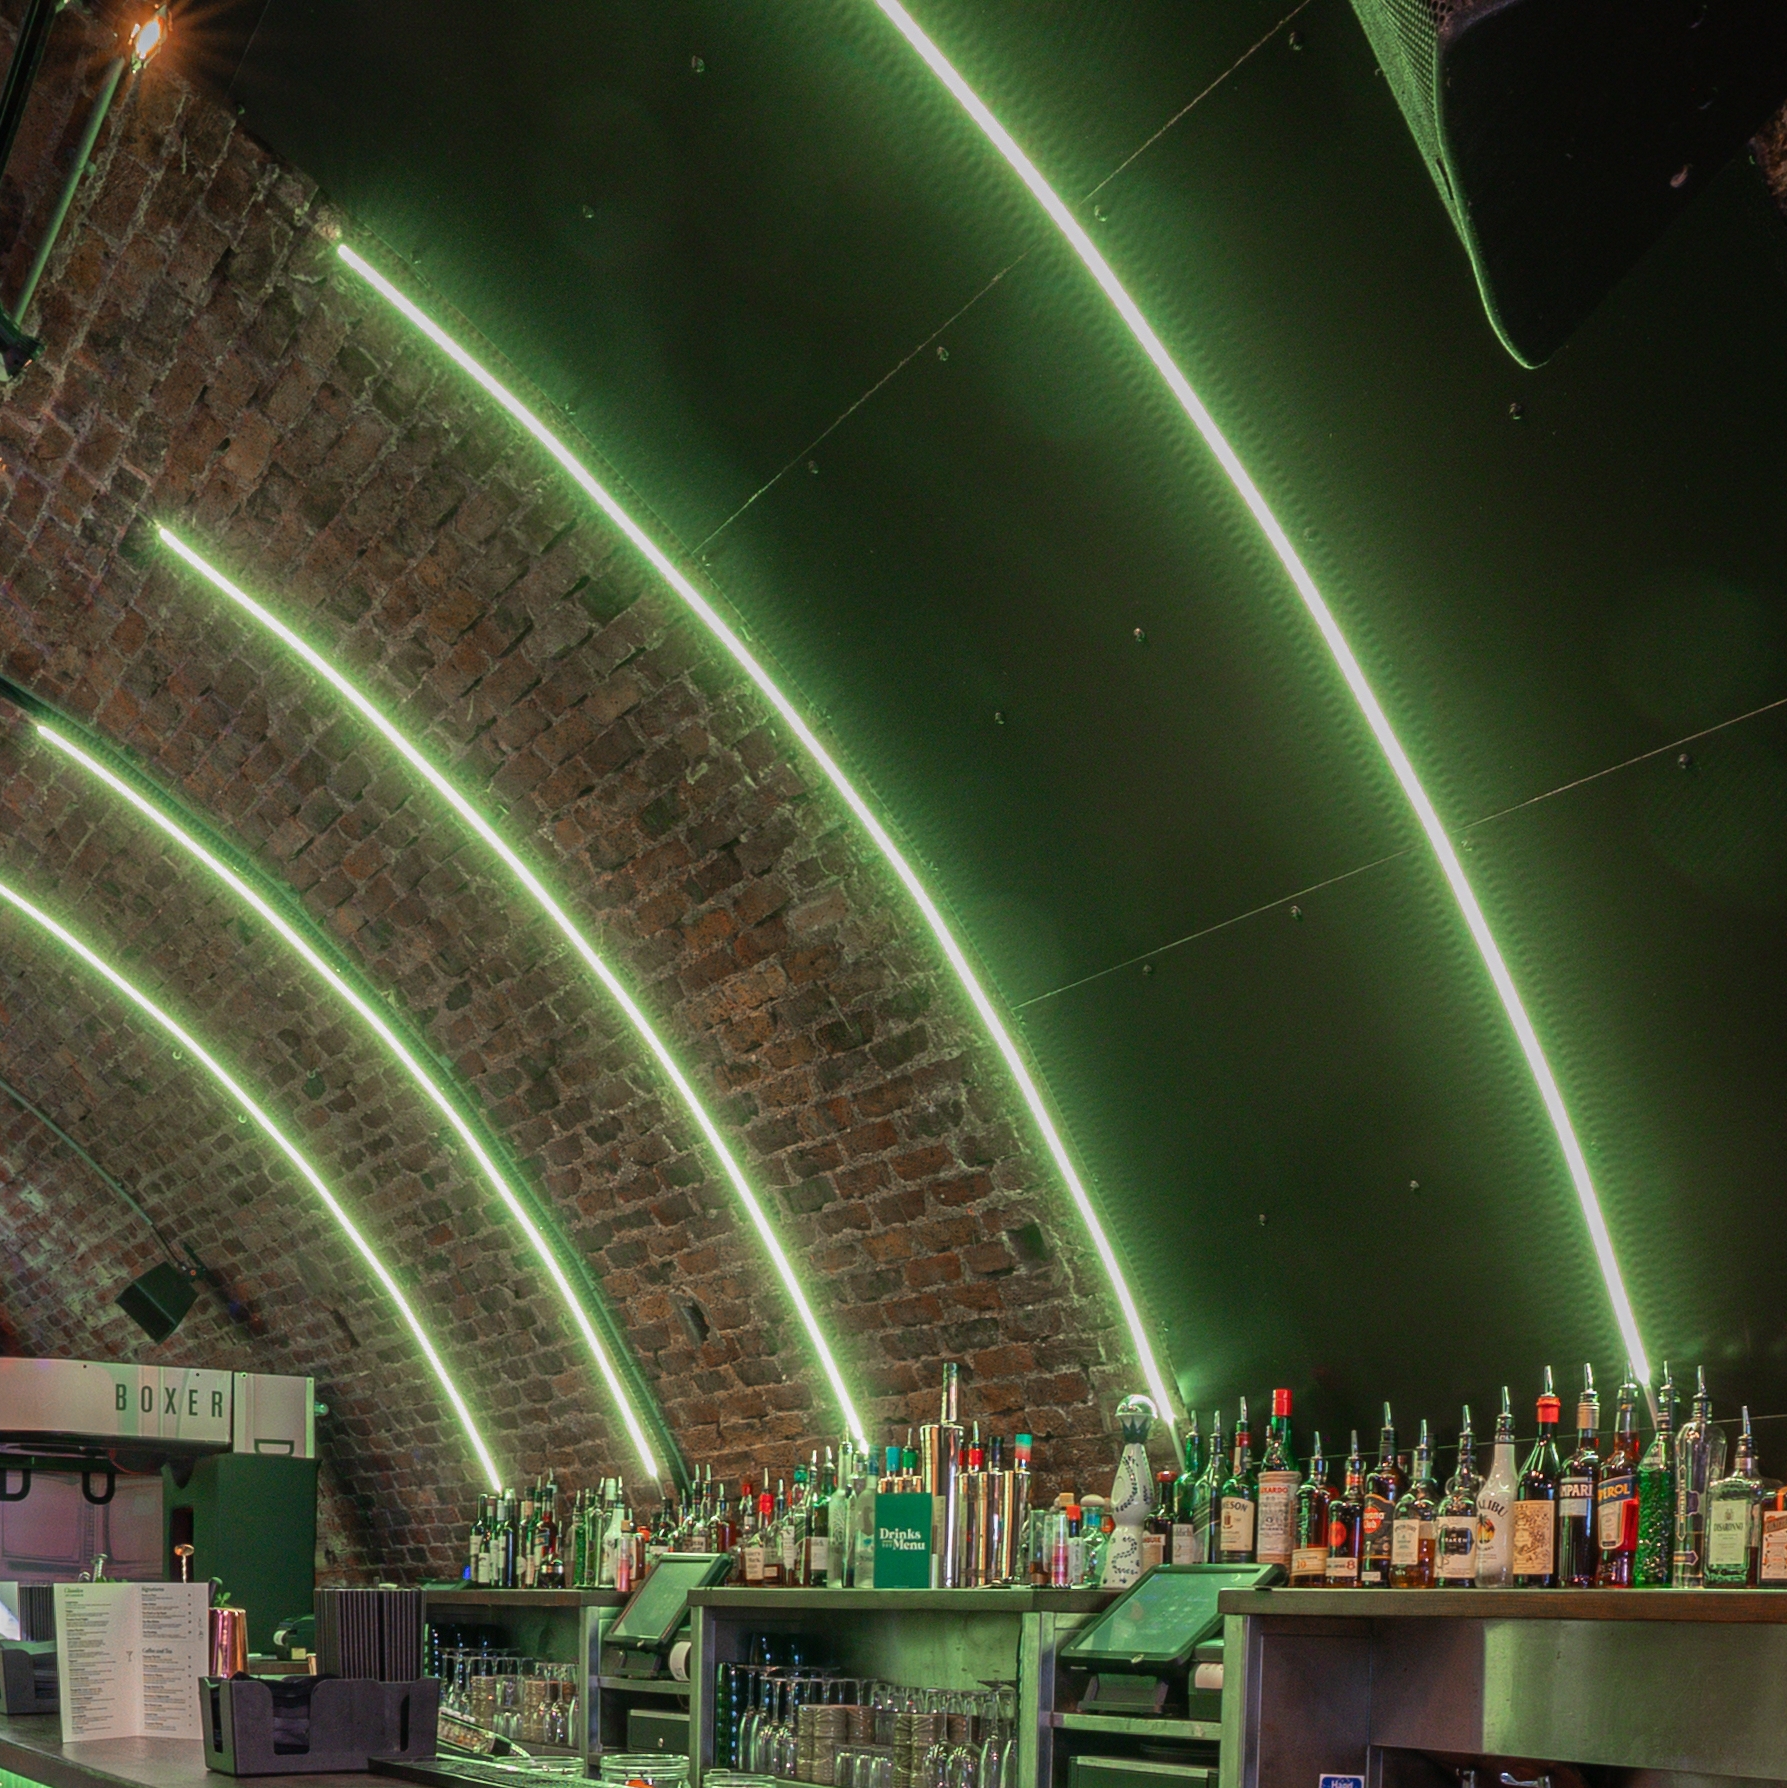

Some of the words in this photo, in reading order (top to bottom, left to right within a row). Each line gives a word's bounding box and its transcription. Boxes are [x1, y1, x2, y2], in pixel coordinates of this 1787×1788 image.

[115, 1383, 224, 1418] BOXER
[879, 1527, 922, 1540] Drinks
[893, 1538, 926, 1550] Menu
